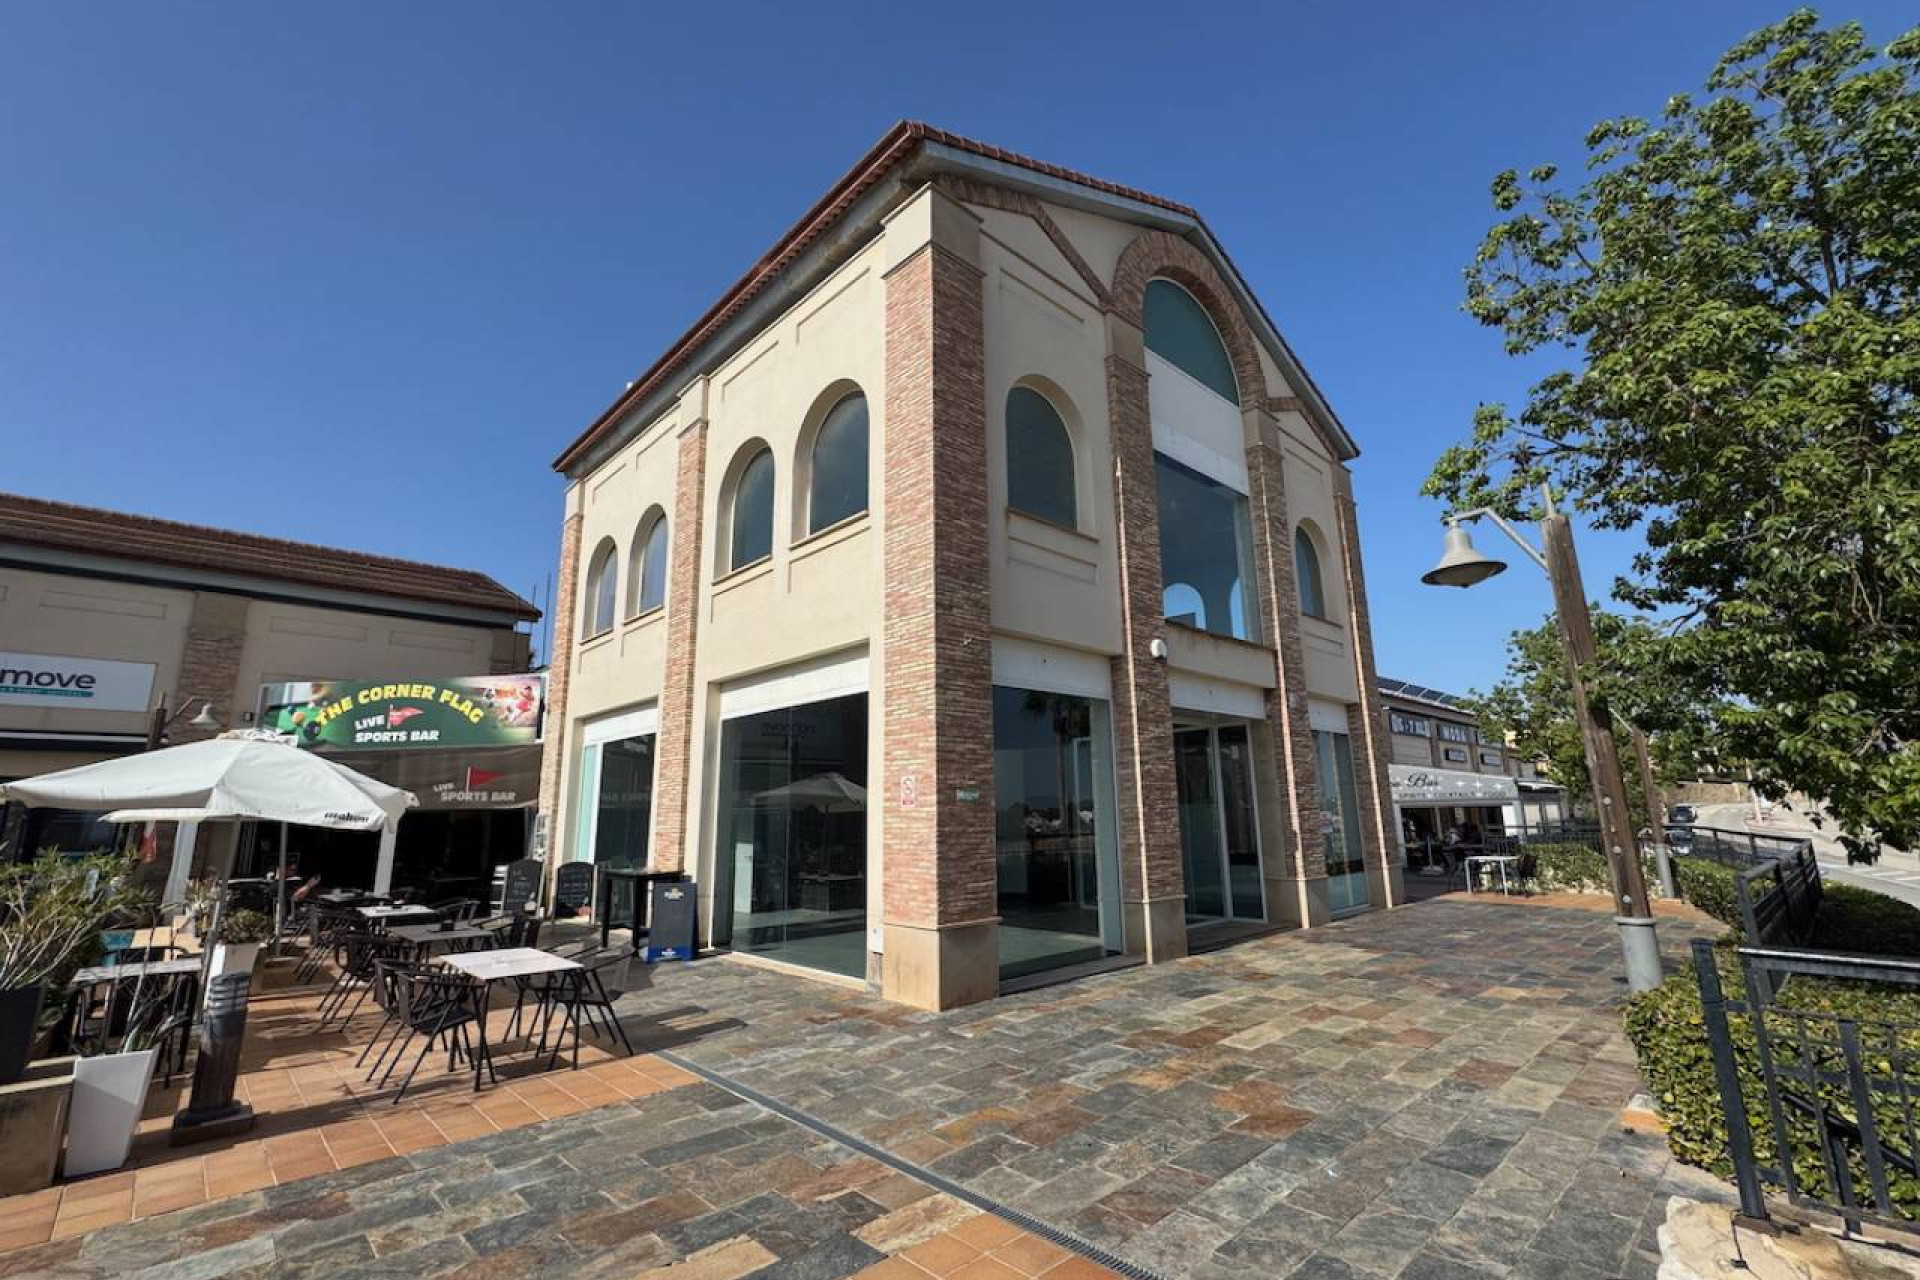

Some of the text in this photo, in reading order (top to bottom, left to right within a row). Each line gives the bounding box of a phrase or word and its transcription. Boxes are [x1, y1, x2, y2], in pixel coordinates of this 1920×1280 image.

[315, 684, 484, 725] THE CORNER FLAG
[354, 714, 385, 731] LIVE
[354, 730, 439, 743] SPORTS BAR
[433, 782, 454, 792] LIVE
[441, 790, 517, 802] SPORTS BAR
